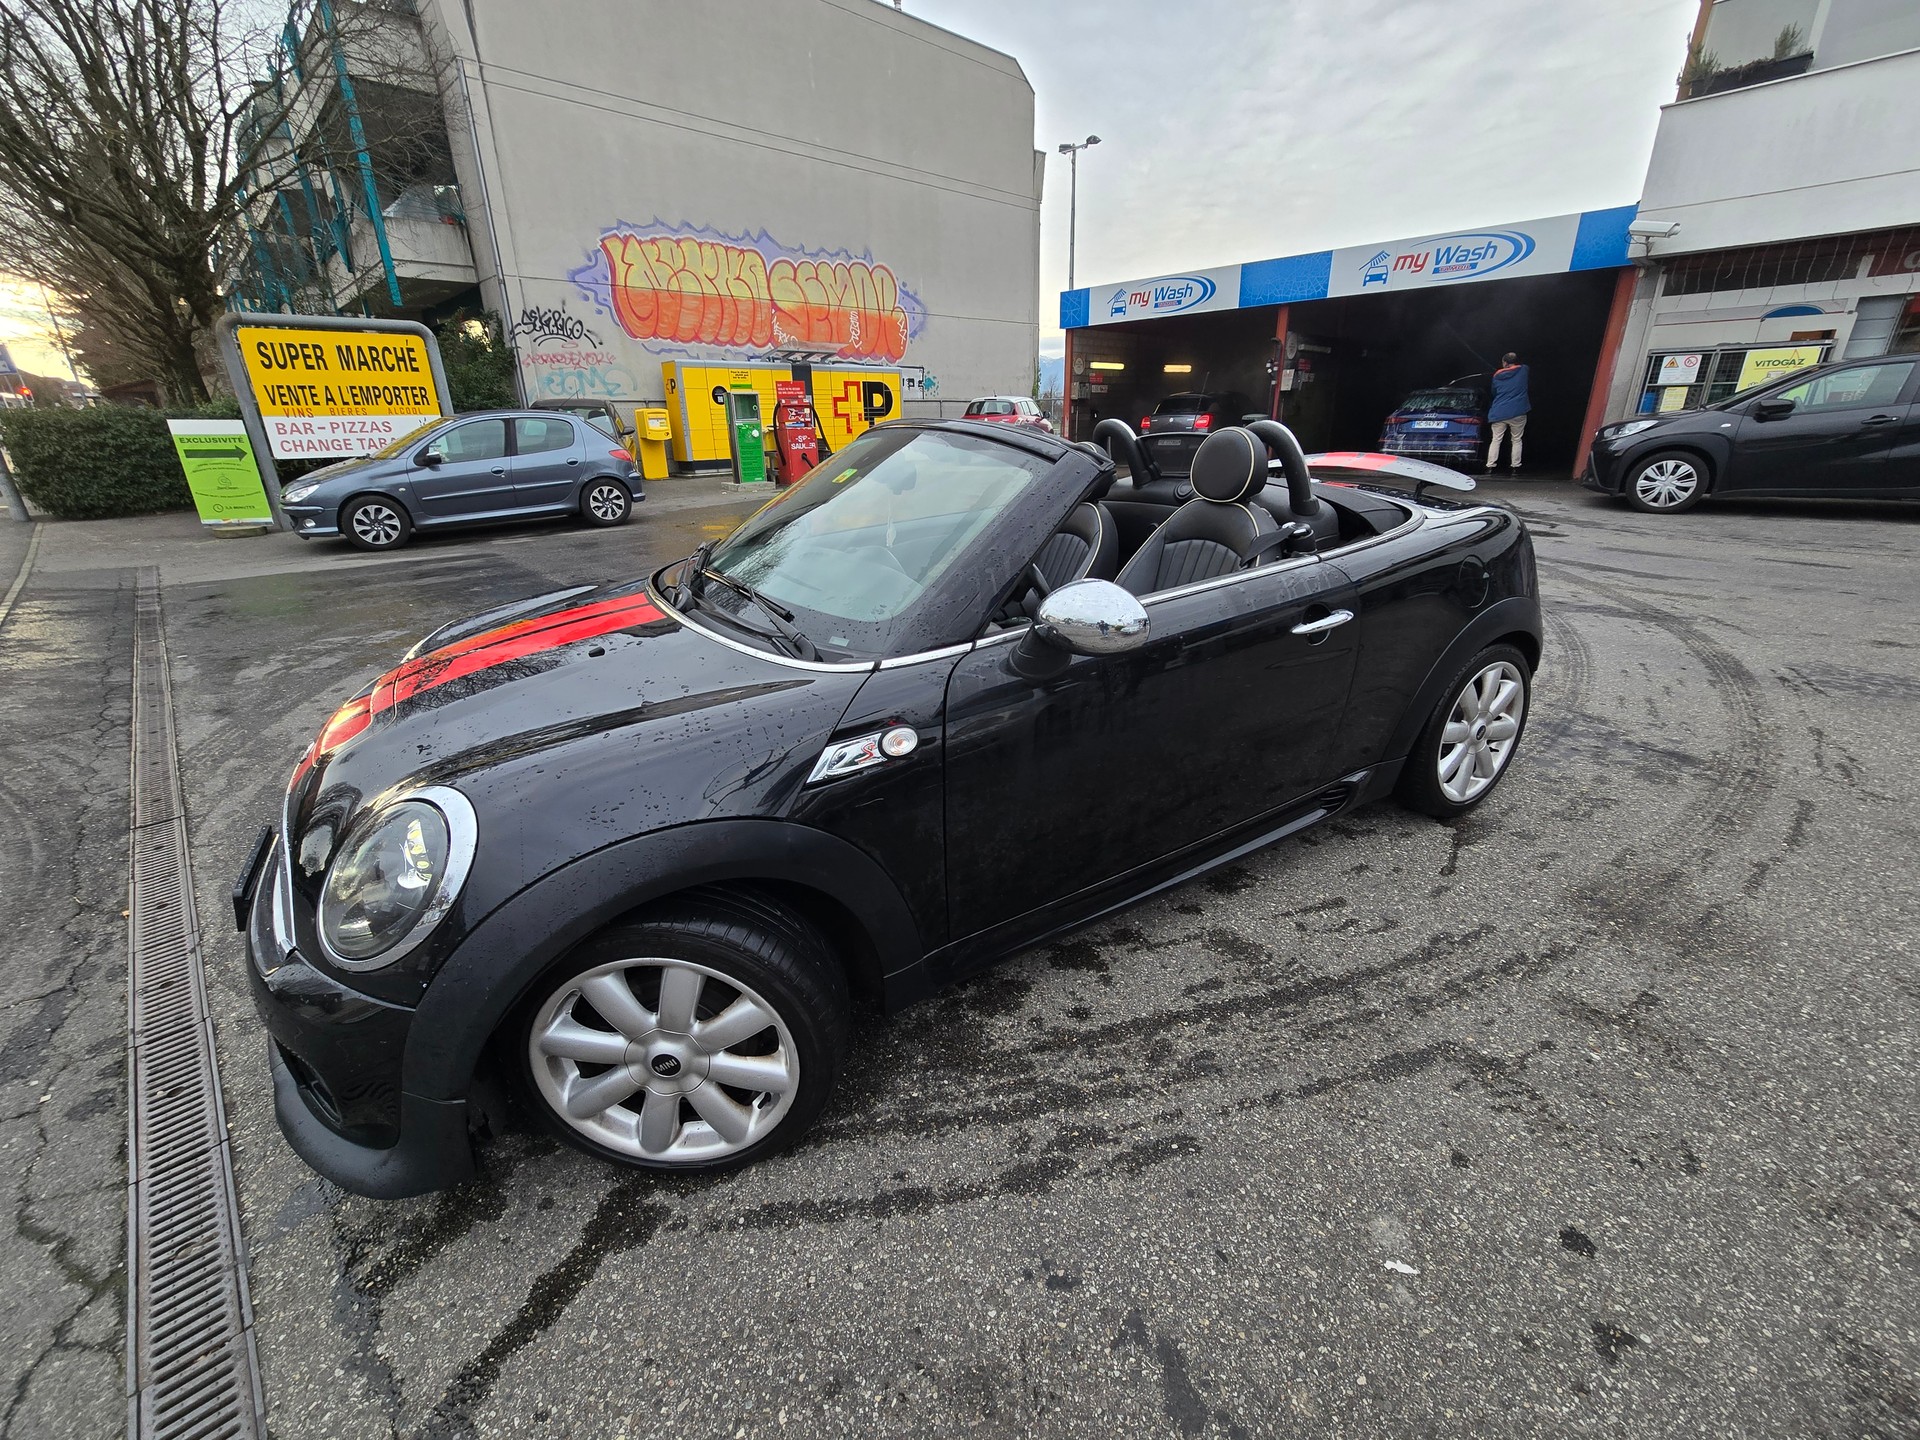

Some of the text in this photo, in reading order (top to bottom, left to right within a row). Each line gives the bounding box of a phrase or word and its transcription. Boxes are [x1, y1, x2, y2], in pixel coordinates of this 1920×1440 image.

[1393, 241, 1498, 274] my Wash
[1129, 291, 1151, 307] my
[1154, 283, 1194, 302] Wash
[256, 339, 420, 373] SUPER MARCHÉ
[1755, 358, 1806, 367] VITOGAZ
[263, 384, 431, 406] VENTE A L'EMPORTER
[283, 407, 423, 418] VINS BIERES ALCOOL
[179, 436, 244, 444] EXCLUSIVITÉ
[280, 438, 354, 453] CHANGE
[654, 1058, 678, 1073] MINI
